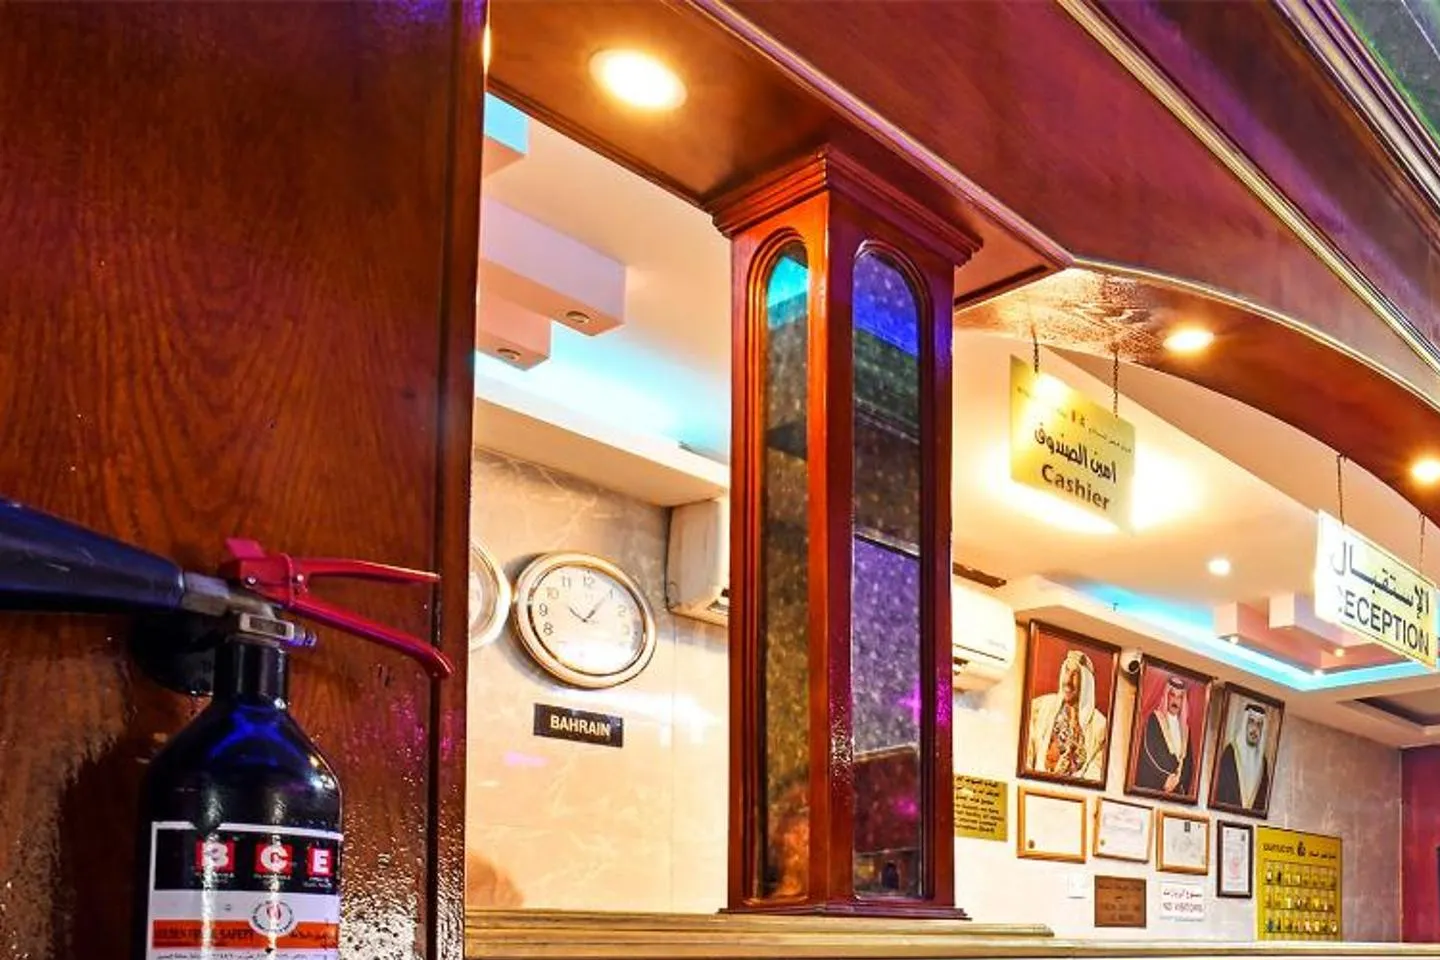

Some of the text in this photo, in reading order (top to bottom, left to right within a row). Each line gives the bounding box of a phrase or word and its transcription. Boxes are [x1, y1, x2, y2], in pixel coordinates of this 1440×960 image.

[1041, 463, 1110, 511] Cashier
[539, 602, 548, 617] 9
[543, 622, 554, 637] 8
[550, 715, 611, 737] BAHRAIN
[202, 841, 229, 868] B
[261, 844, 289, 872] C
[313, 848, 329, 874] E
